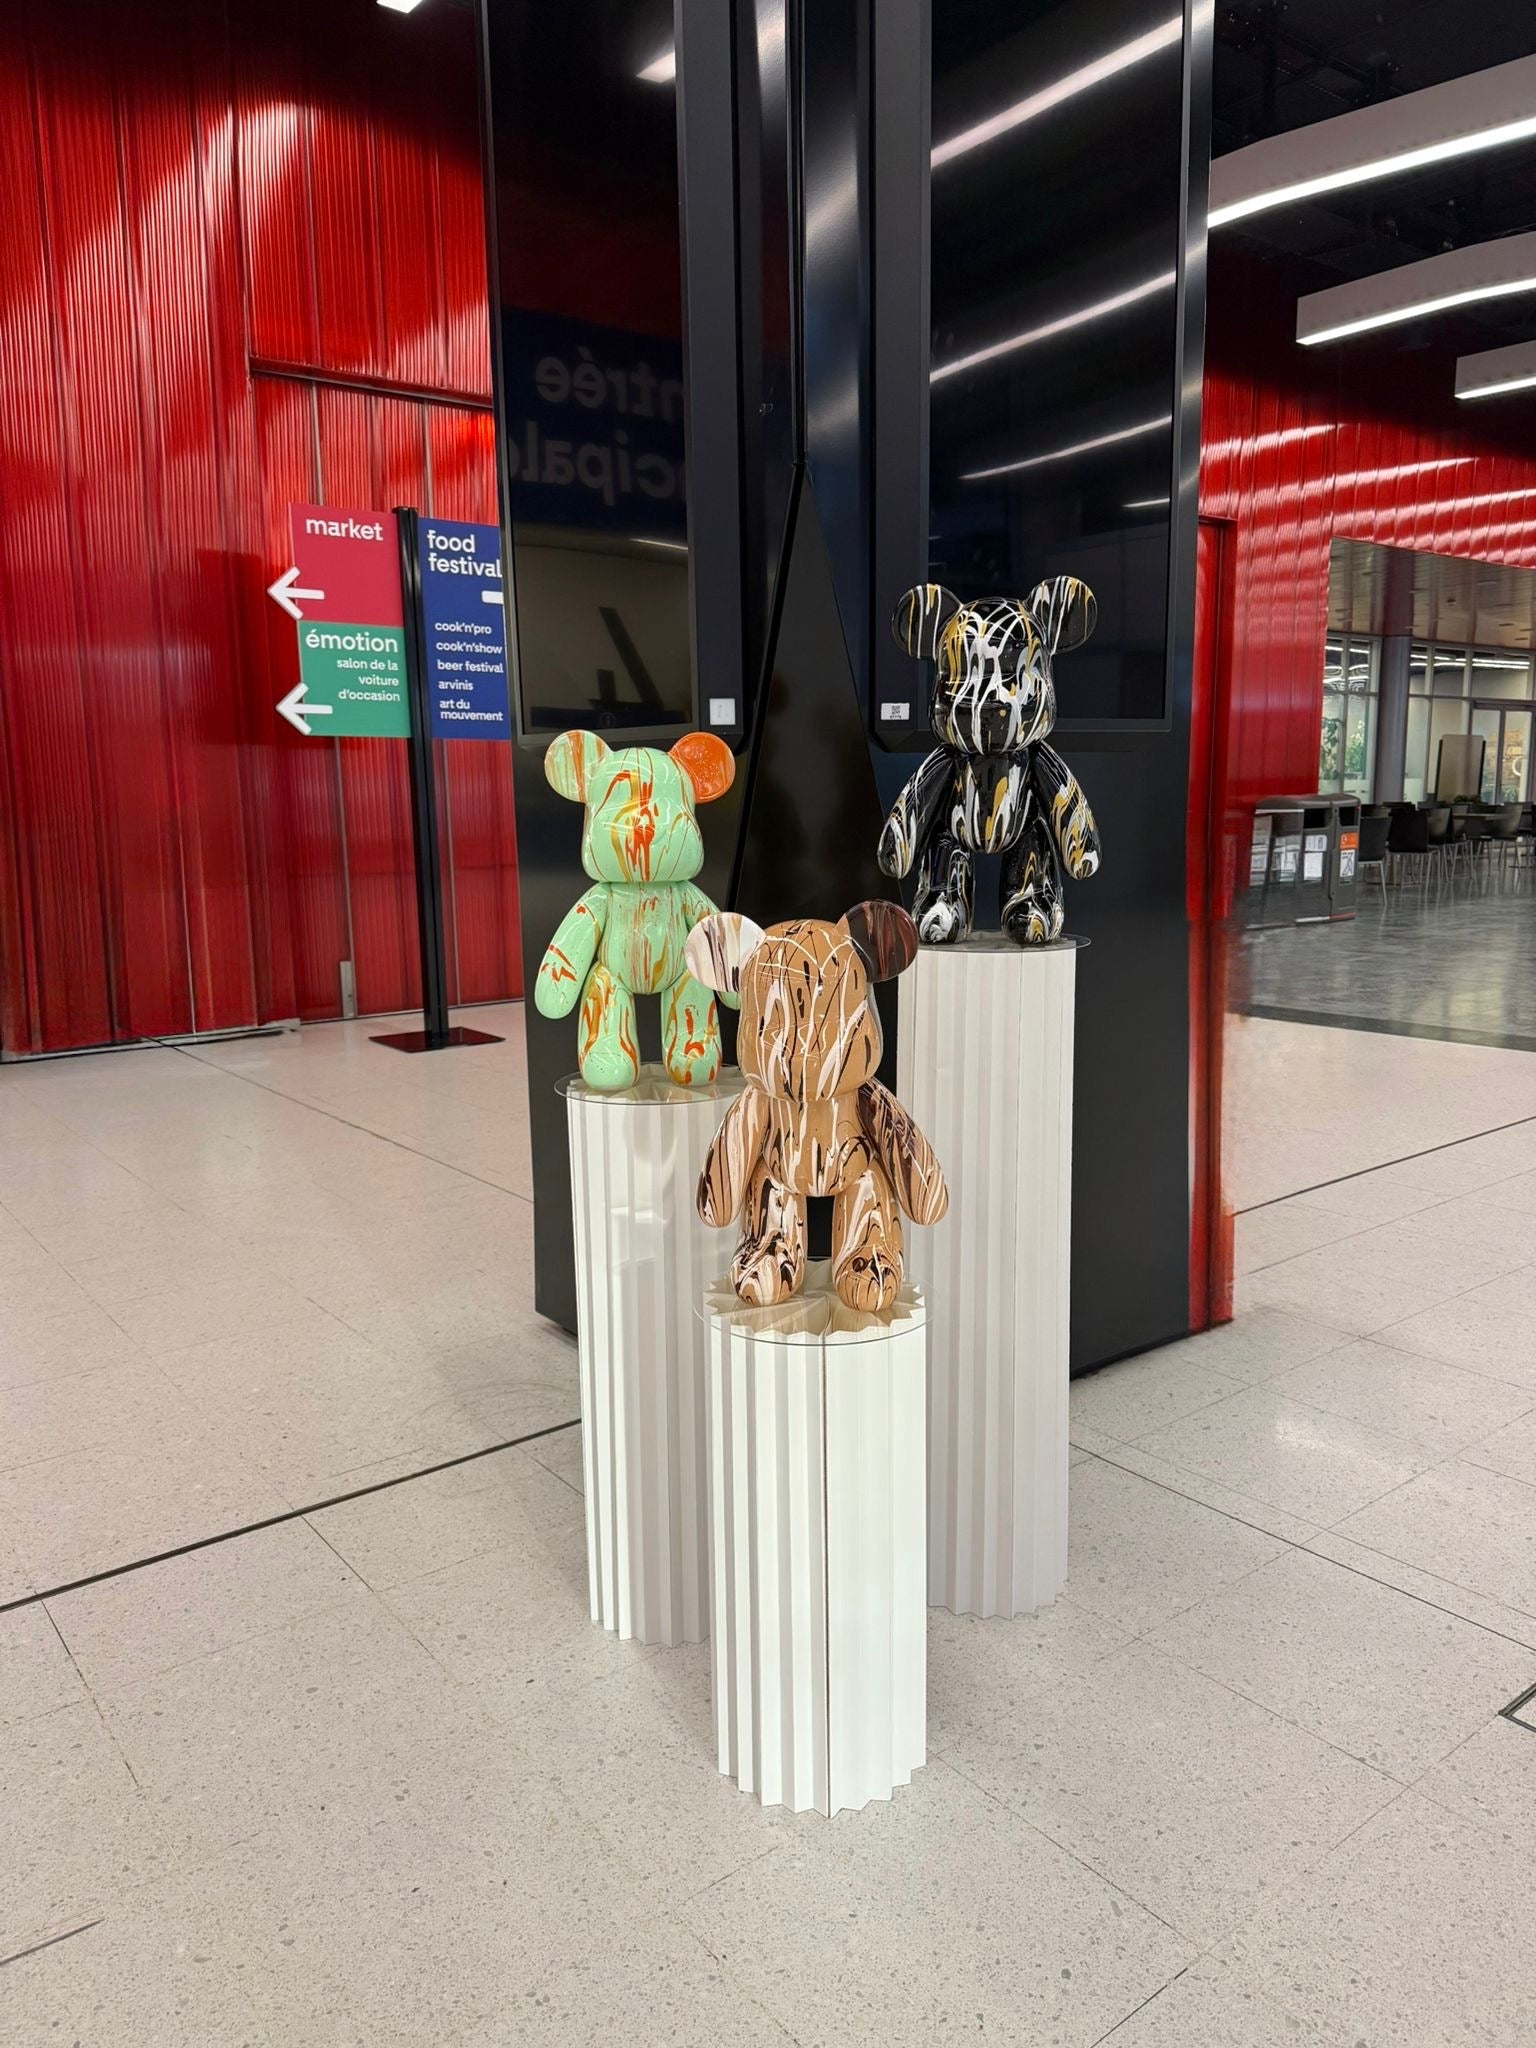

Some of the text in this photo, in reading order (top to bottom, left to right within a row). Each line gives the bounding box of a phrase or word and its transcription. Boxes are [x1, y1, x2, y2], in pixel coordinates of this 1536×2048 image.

[306, 518, 383, 541] market
[427, 530, 475, 553] food
[428, 552, 502, 578] festival
[435, 621, 492, 635] cook'n'pro
[305, 629, 398, 653] émotion
[436, 641, 502, 655] cook'n'show
[337, 658, 399, 671] salon de la
[437, 660, 503, 673] beer festival
[358, 675, 399, 687] voiture
[438, 680, 474, 691] arvinis
[338, 689, 400, 701] d'occasion
[439, 699, 470, 710] art du
[440, 710, 503, 721] mouvement
